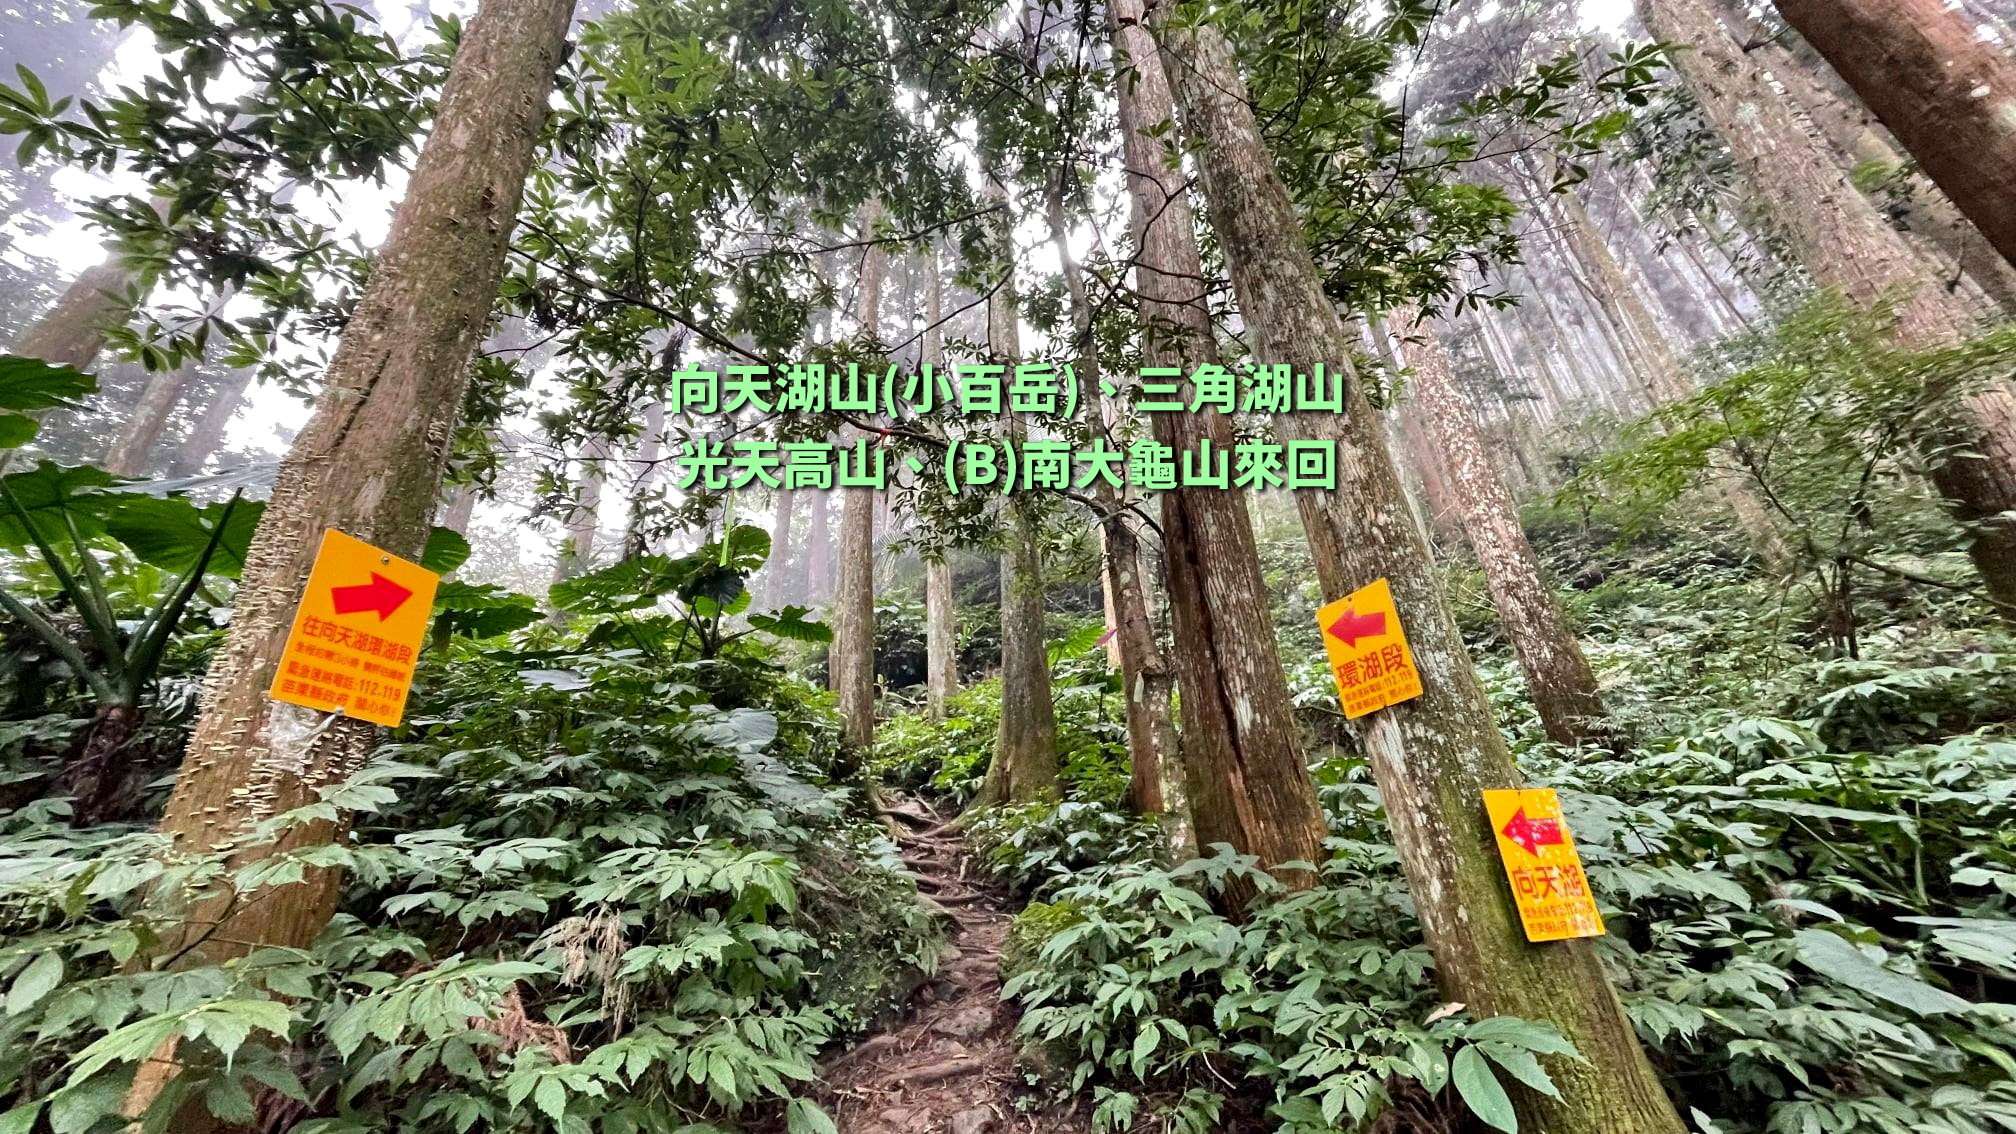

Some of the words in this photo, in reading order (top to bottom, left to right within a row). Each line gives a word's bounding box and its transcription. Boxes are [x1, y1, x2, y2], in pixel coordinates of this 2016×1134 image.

[302, 615, 413, 666] 往向天湖環湖段
[1337, 643, 1408, 689] 環湖段
[1512, 864, 1585, 900] 向天湖
